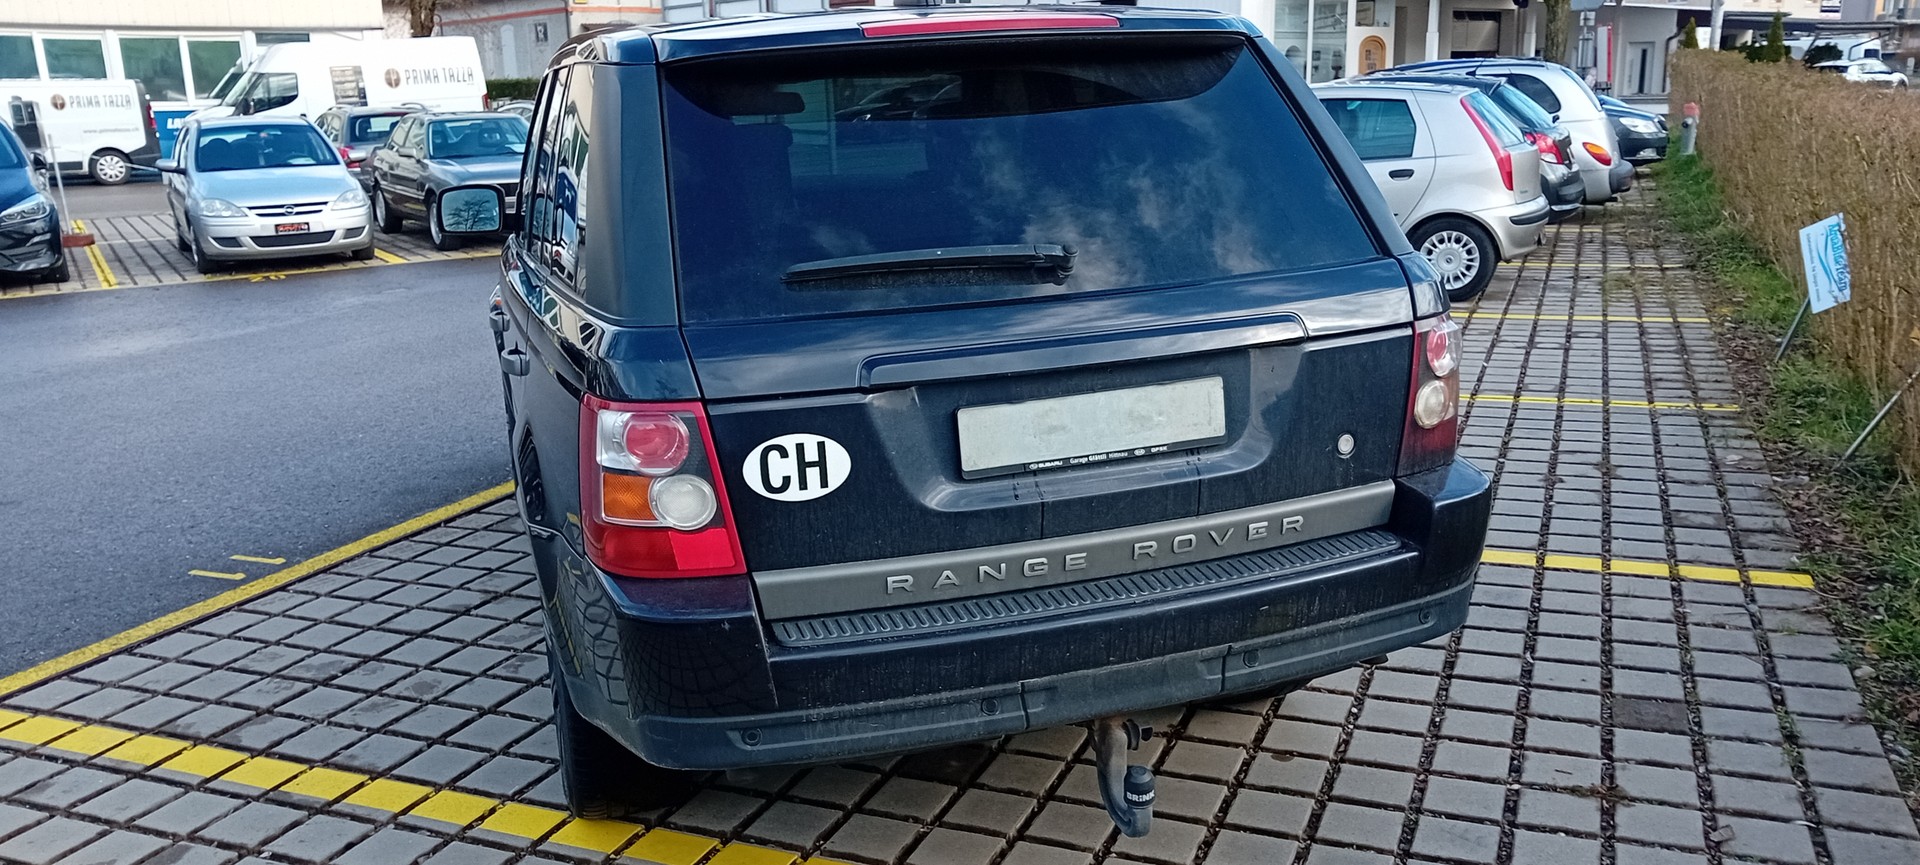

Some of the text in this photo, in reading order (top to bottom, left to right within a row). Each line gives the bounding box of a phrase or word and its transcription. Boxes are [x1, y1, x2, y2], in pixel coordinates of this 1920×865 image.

[404, 67, 474, 85] PRIMA TAZZA
[69, 94, 132, 109] PRIMA TAZZA
[760, 441, 829, 494] CH
[1038, 460, 1063, 468] SUBARU
[886, 515, 1305, 595] RANGE ROVER
